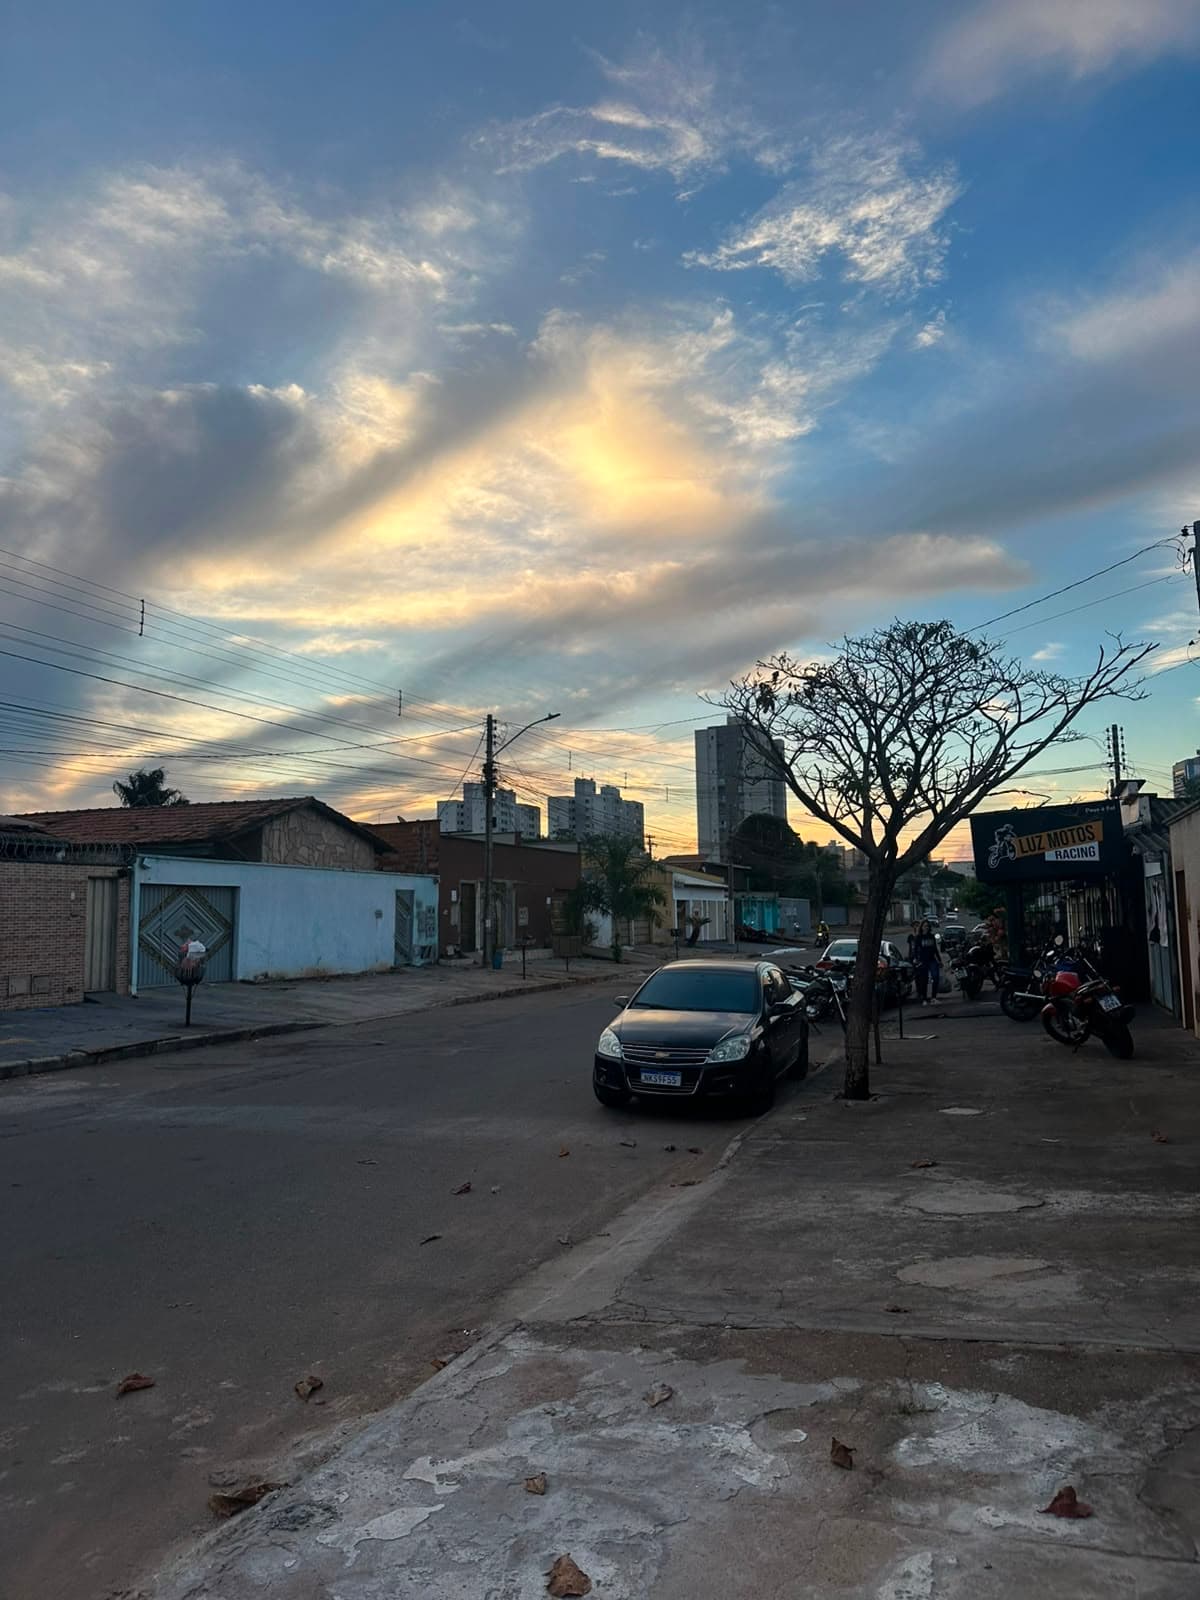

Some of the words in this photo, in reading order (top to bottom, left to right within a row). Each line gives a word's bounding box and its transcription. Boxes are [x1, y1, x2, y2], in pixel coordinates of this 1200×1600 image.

[1018, 834, 1046, 854] LUZ
[1047, 825, 1096, 848] MOTOS
[1055, 846, 1096, 860] RACING
